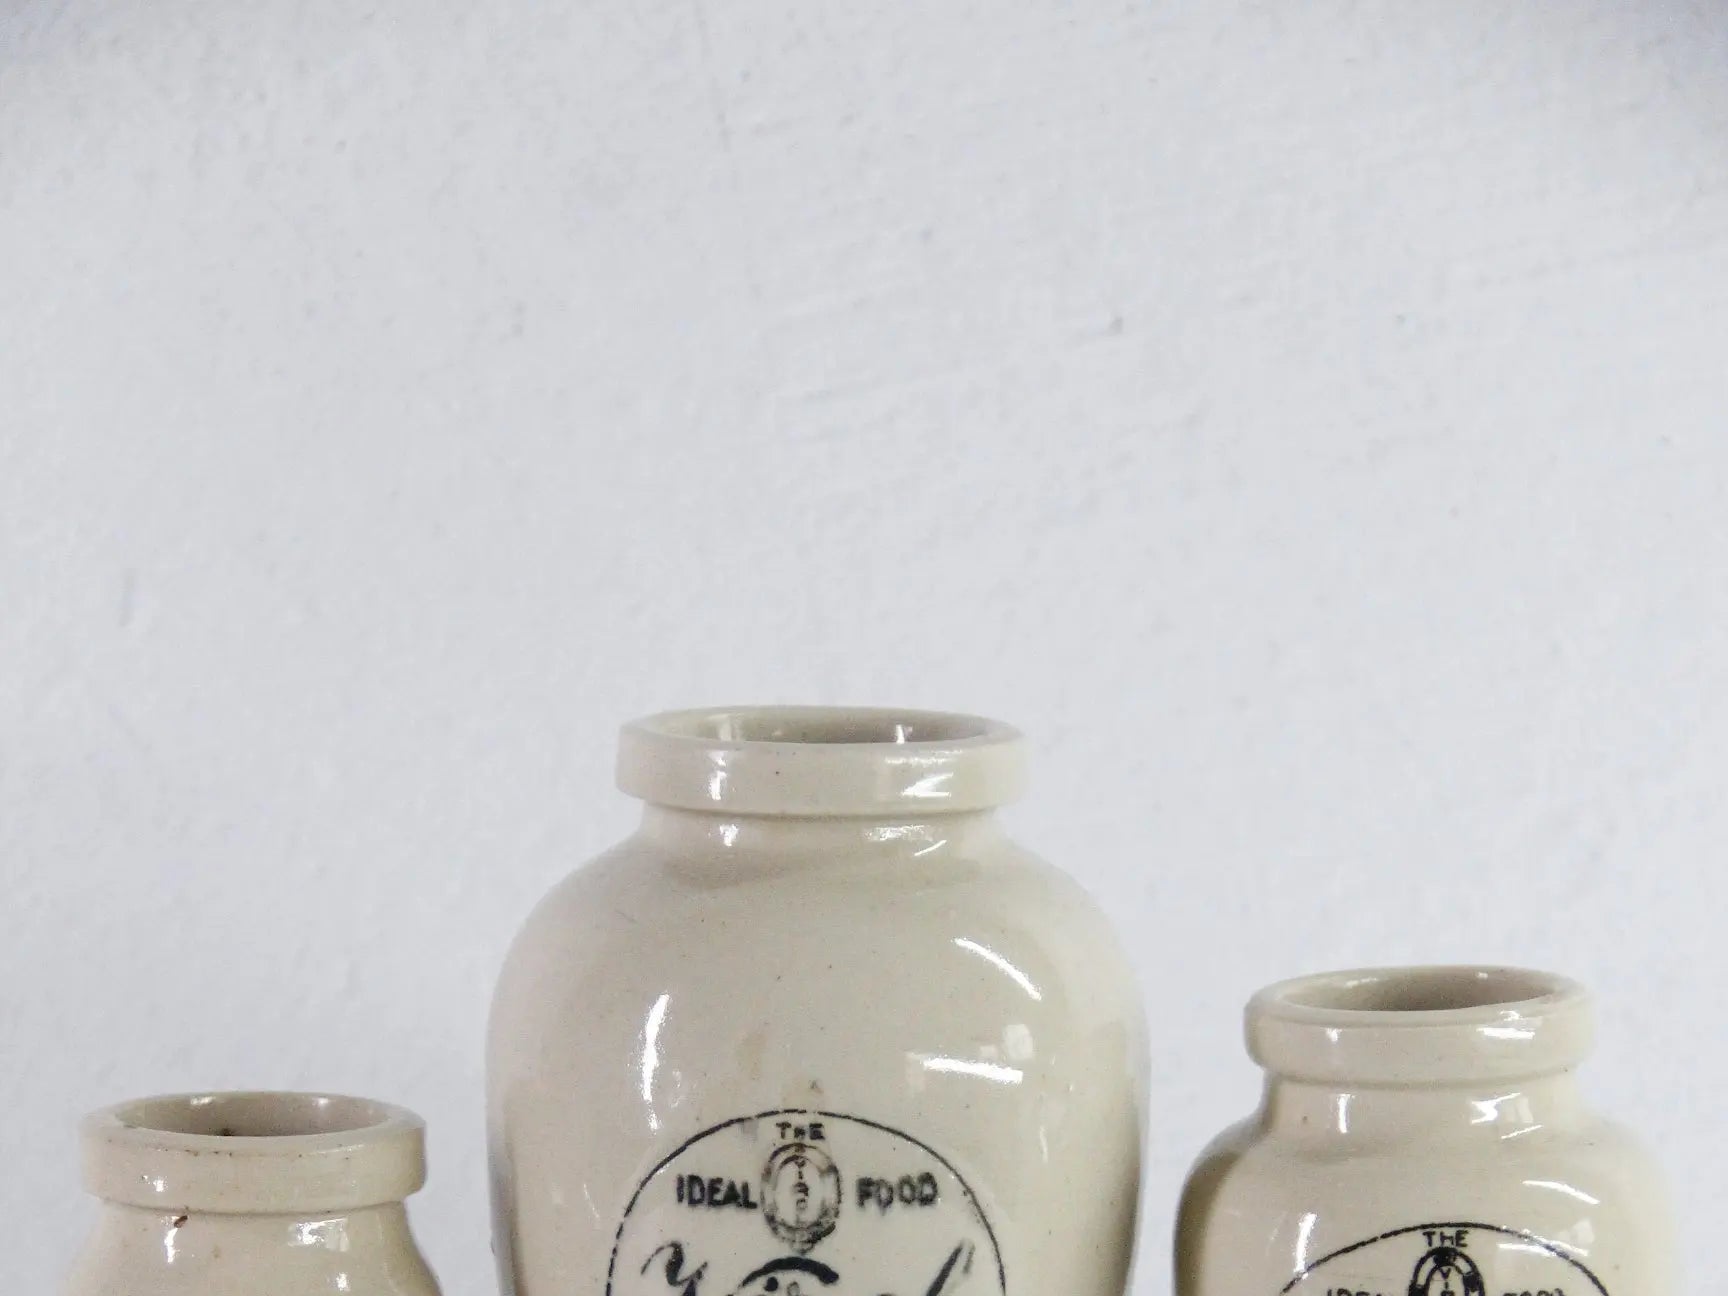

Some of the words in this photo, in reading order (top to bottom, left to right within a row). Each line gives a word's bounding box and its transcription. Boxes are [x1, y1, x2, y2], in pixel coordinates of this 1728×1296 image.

[776, 1122, 825, 1140] THE
[677, 1174, 758, 1209] IDEAL
[856, 1173, 938, 1207] FOOD
[1423, 1230, 1468, 1248] THE
